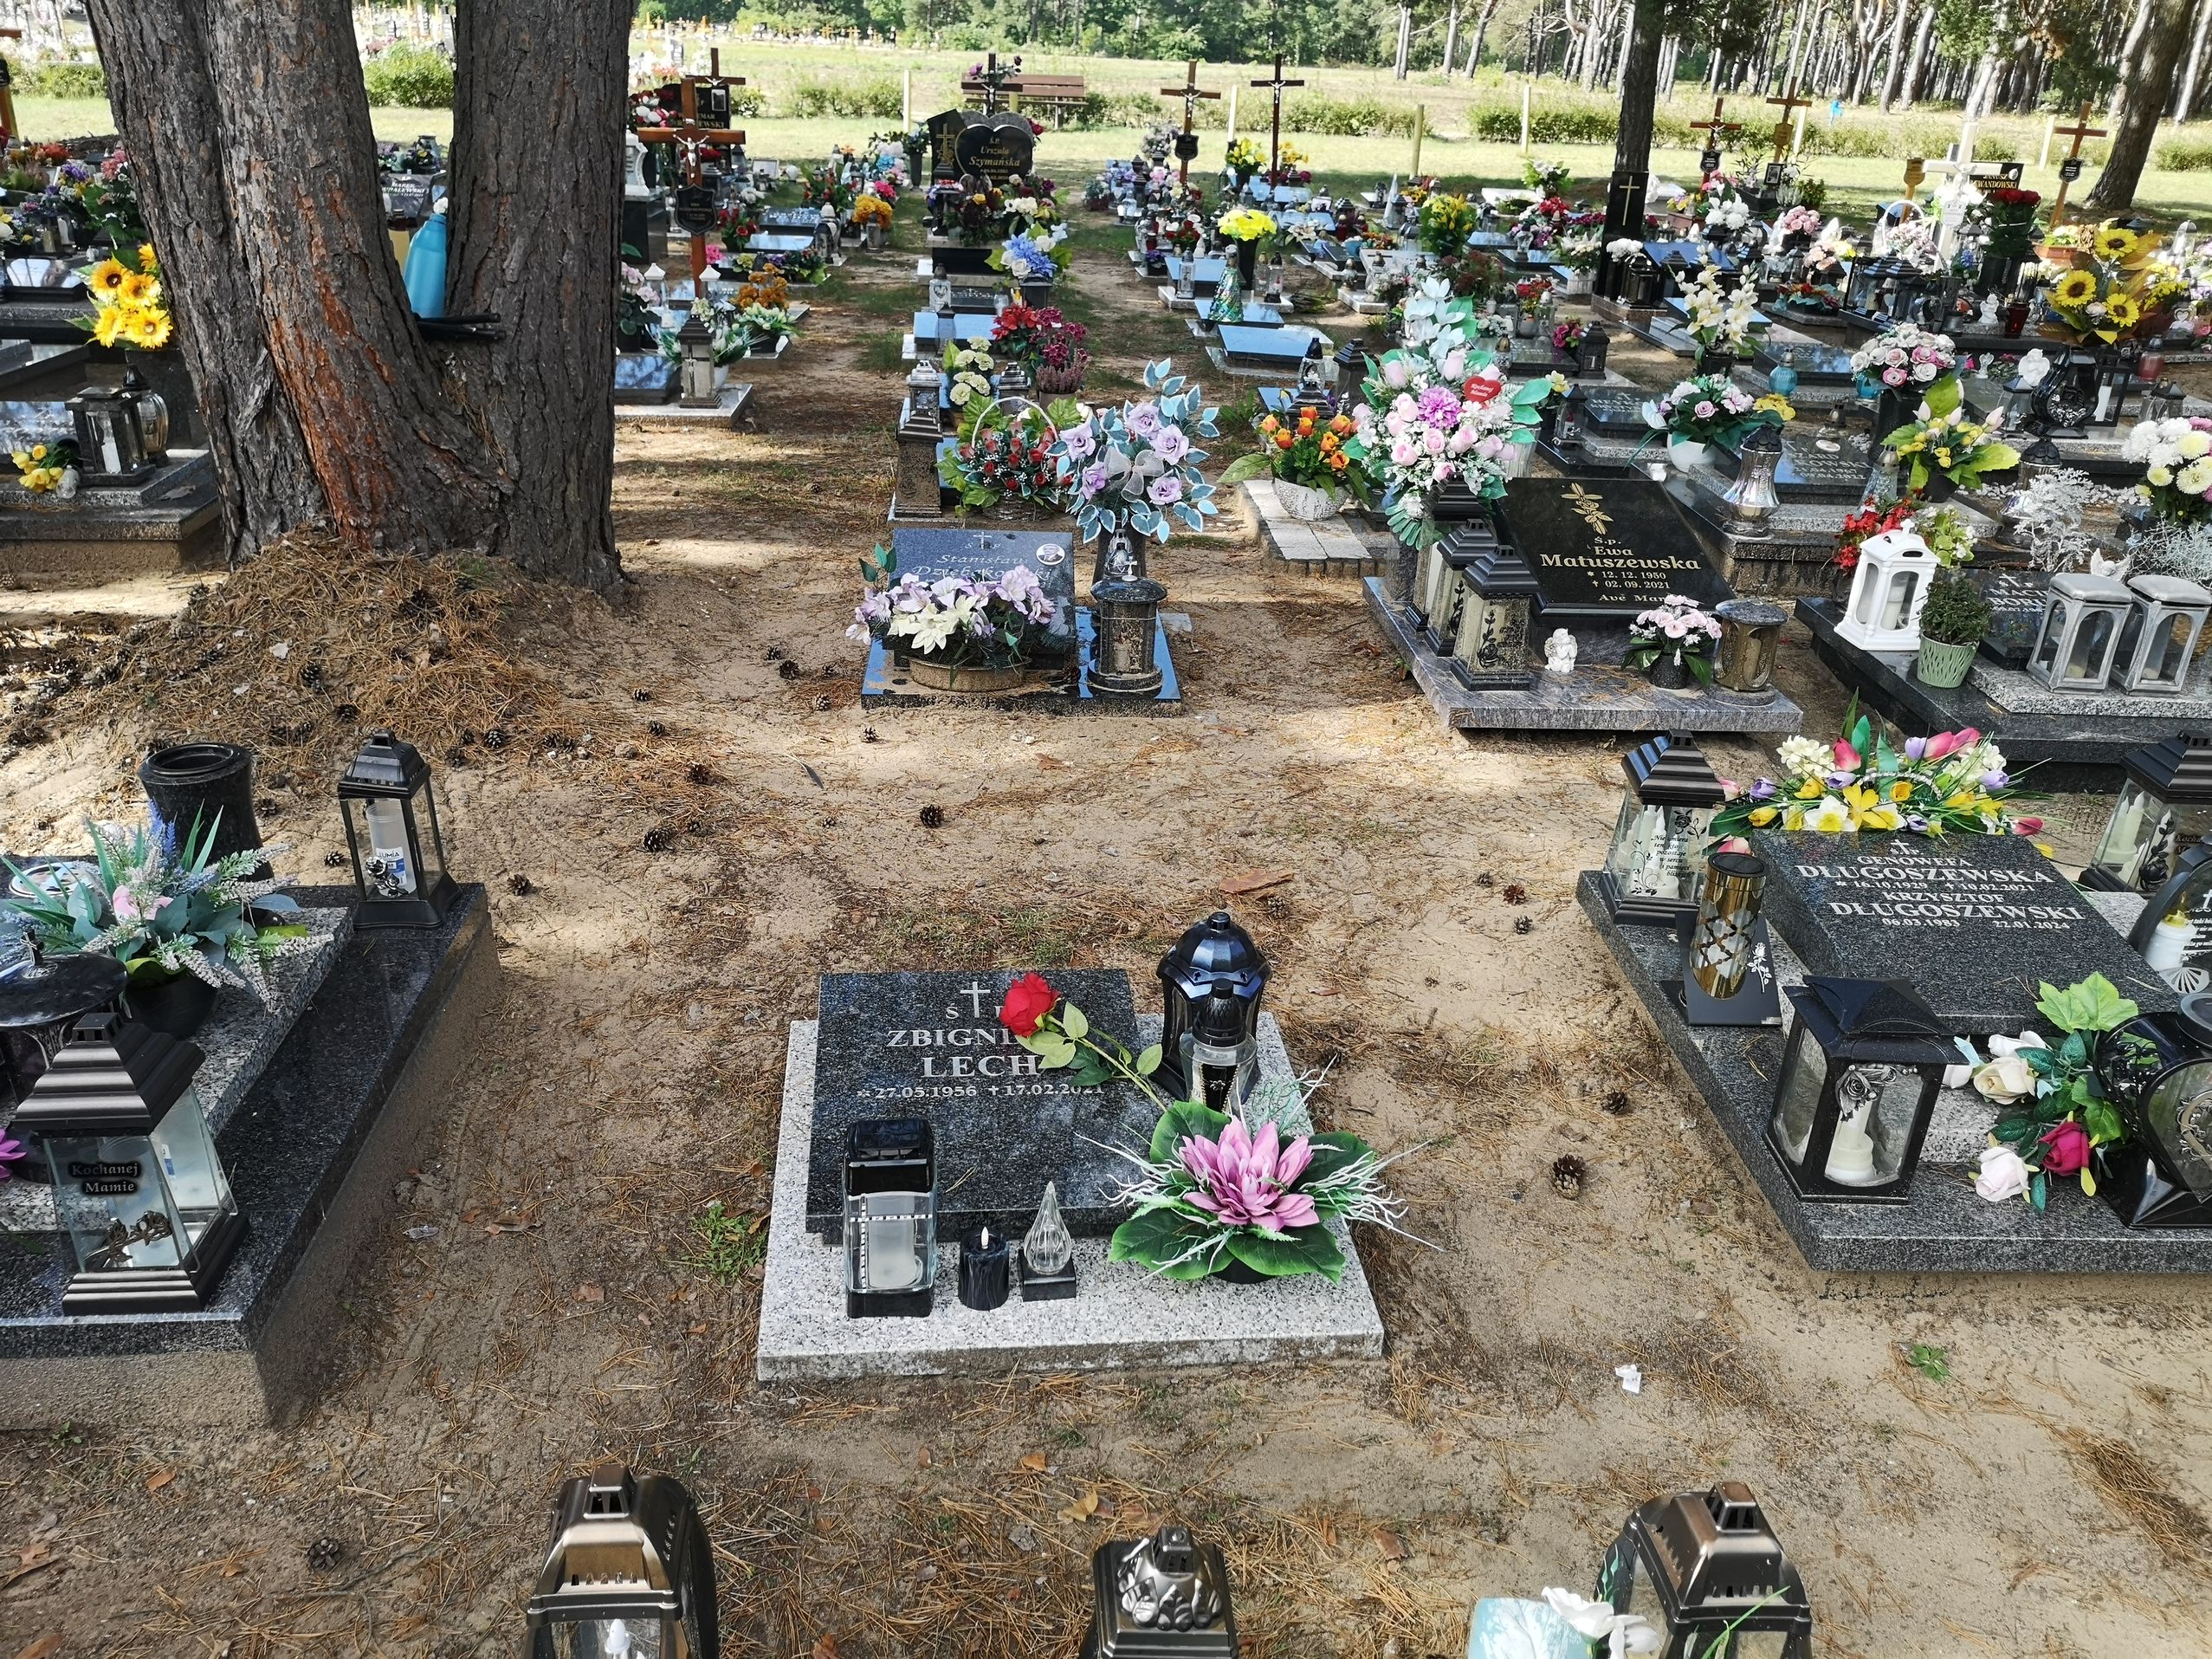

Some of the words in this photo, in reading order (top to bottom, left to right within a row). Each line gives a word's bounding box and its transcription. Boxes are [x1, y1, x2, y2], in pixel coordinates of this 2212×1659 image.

[980, 146, 1010, 155] Urszula
[969, 155, 1020, 167] Szymańska
[1594, 546, 1634, 556] Ewa
[1540, 554, 1702, 570] Matuszewska
[1857, 856, 1973, 866] GENOWEFA
[1795, 865, 2056, 883] DŁUGOSZEWSKA
[1853, 880, 1928, 889] 16.10.1929
[1960, 883, 2035, 891] 10.02.2021
[1882, 891, 2004, 903] KRZYSZTOF
[1827, 902, 2086, 920] DŁUGOSZEWSKI
[1881, 918, 1960, 927] 06.03.1983
[1992, 920, 2071, 930] 22.01.2024
[886, 1027, 1018, 1047] ZBIGNI
[921, 1054, 1040, 1078] LECH
[874, 1085, 977, 1098] 27.05.1956
[72, 1163, 139, 1176] Kochanej
[85, 1181, 135, 1193] Mamie
